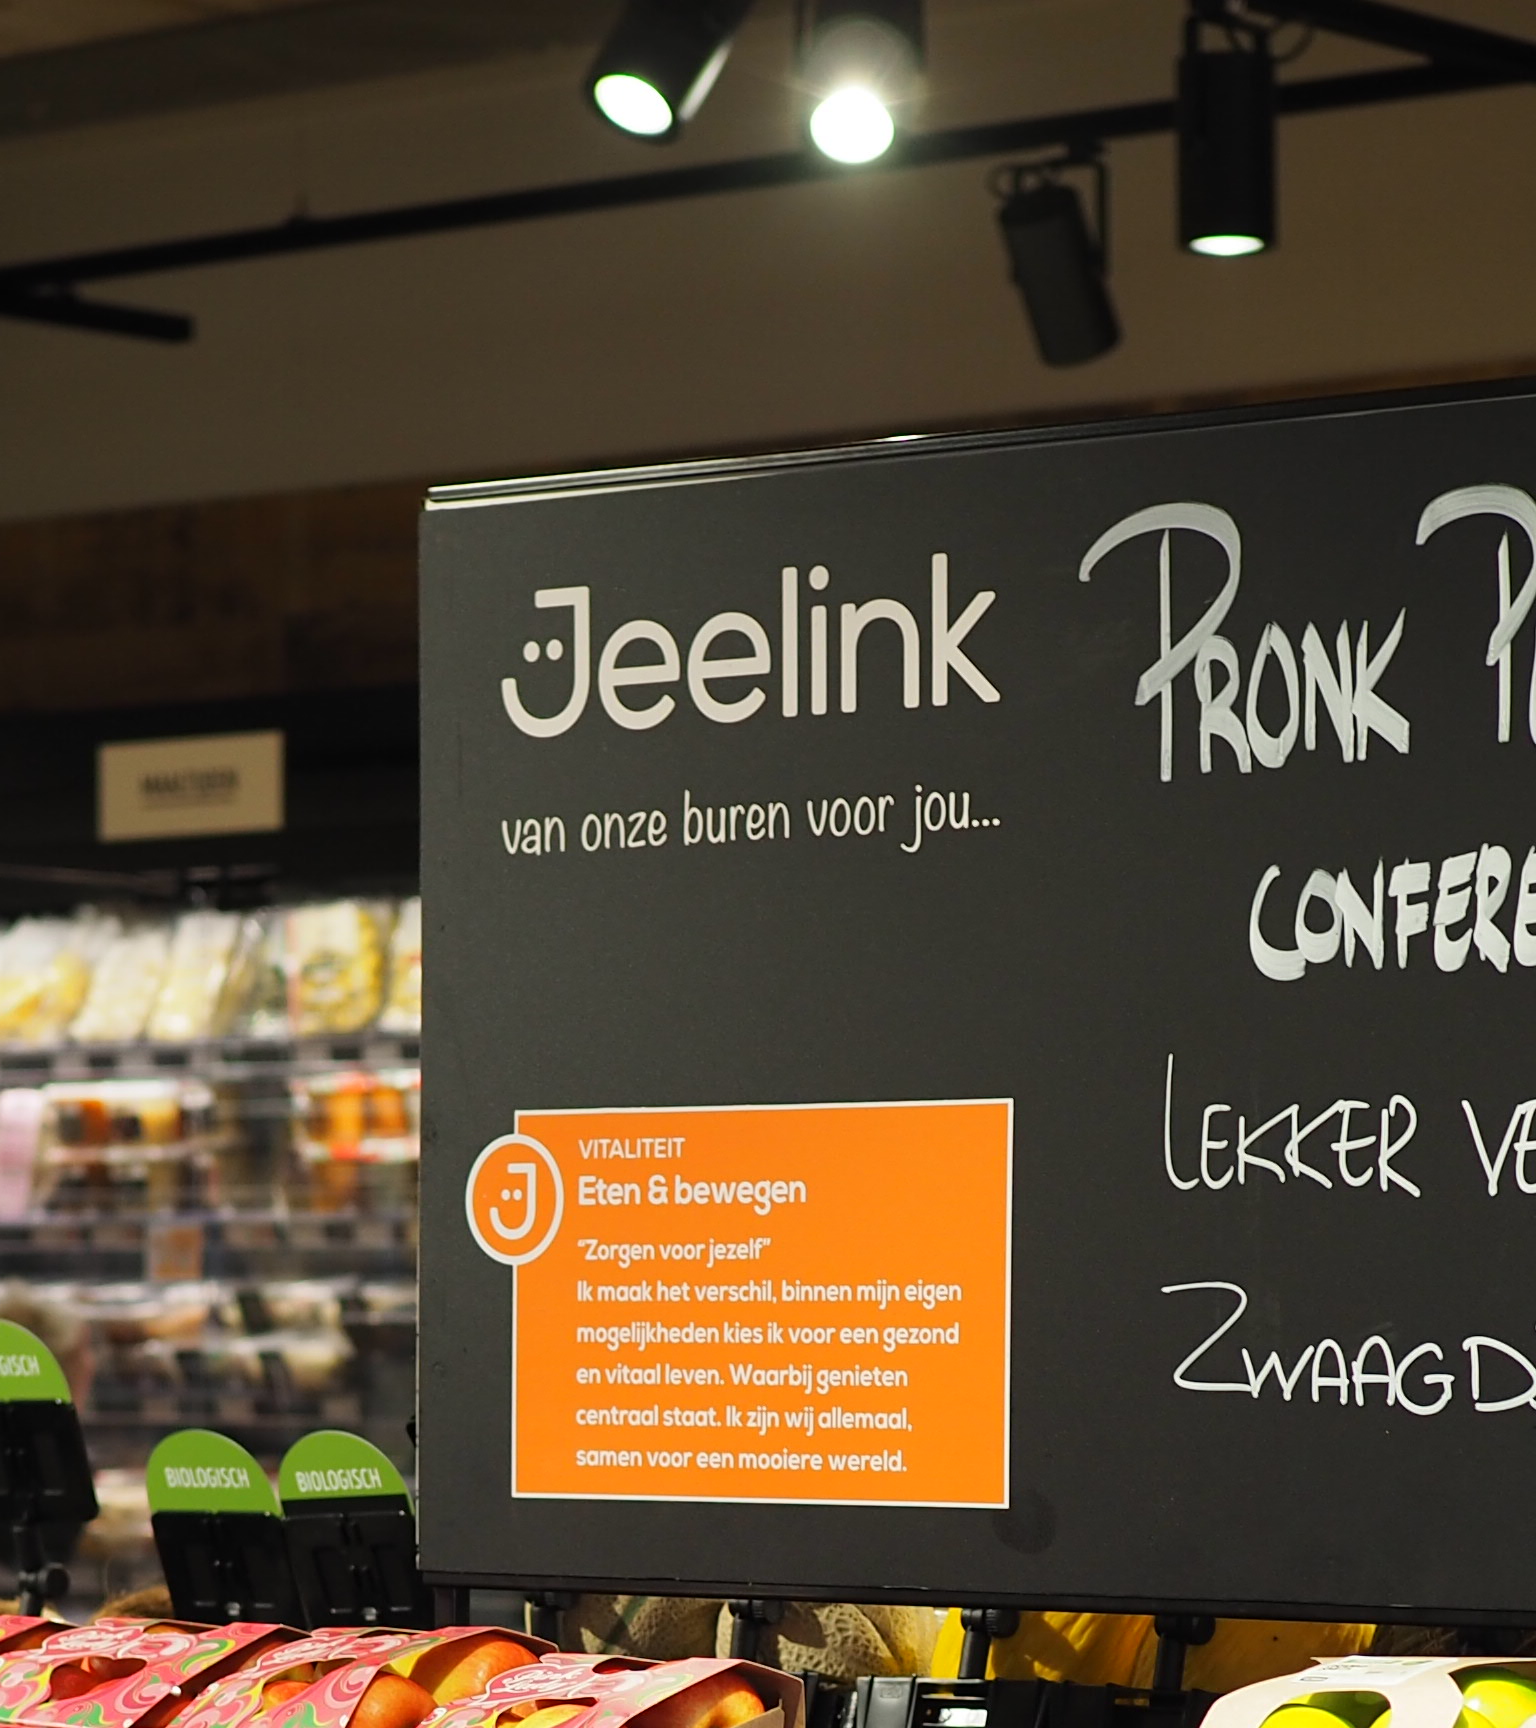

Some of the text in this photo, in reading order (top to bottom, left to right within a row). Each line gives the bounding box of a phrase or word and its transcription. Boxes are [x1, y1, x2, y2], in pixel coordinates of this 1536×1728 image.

[501, 552, 1001, 738] Jeelink
[1079, 501, 1410, 783] PRONK
[502, 814, 565, 856] van
[580, 808, 668, 852] onze
[682, 790, 791, 846] buren
[807, 795, 895, 837] voor
[1165, 1053, 1421, 1199] LEKKER
[578, 1137, 686, 1160] VITALITEIT
[577, 1174, 808, 1216] Eten & bewegen
[659, 1245, 705, 1261] voor
[597, 1281, 653, 1302] maak
[657, 1281, 690, 1302] het
[694, 1281, 777, 1304] verschil,
[781, 1281, 853, 1302] binnen
[856, 1281, 900, 1310] mijn
[904, 1281, 963, 1310] eigen
[576, 1322, 960, 1353] mogelijkheden kies ik voor een gezond
[576, 1364, 909, 1395] en vitaal leven. Waarbij genieten
[576, 1405, 659, 1428] centraal
[662, 1407, 722, 1428] staat.
[746, 1406, 781, 1436] zijn
[784, 1406, 815, 1436] wij
[817, 1406, 914, 1433] allemaal,
[576, 1449, 908, 1472] samen voor een mooiere wereld.
[163, 1465, 251, 1490] BIOLOGISCH
[294, 1466, 383, 1494] BIOLOGISCH
